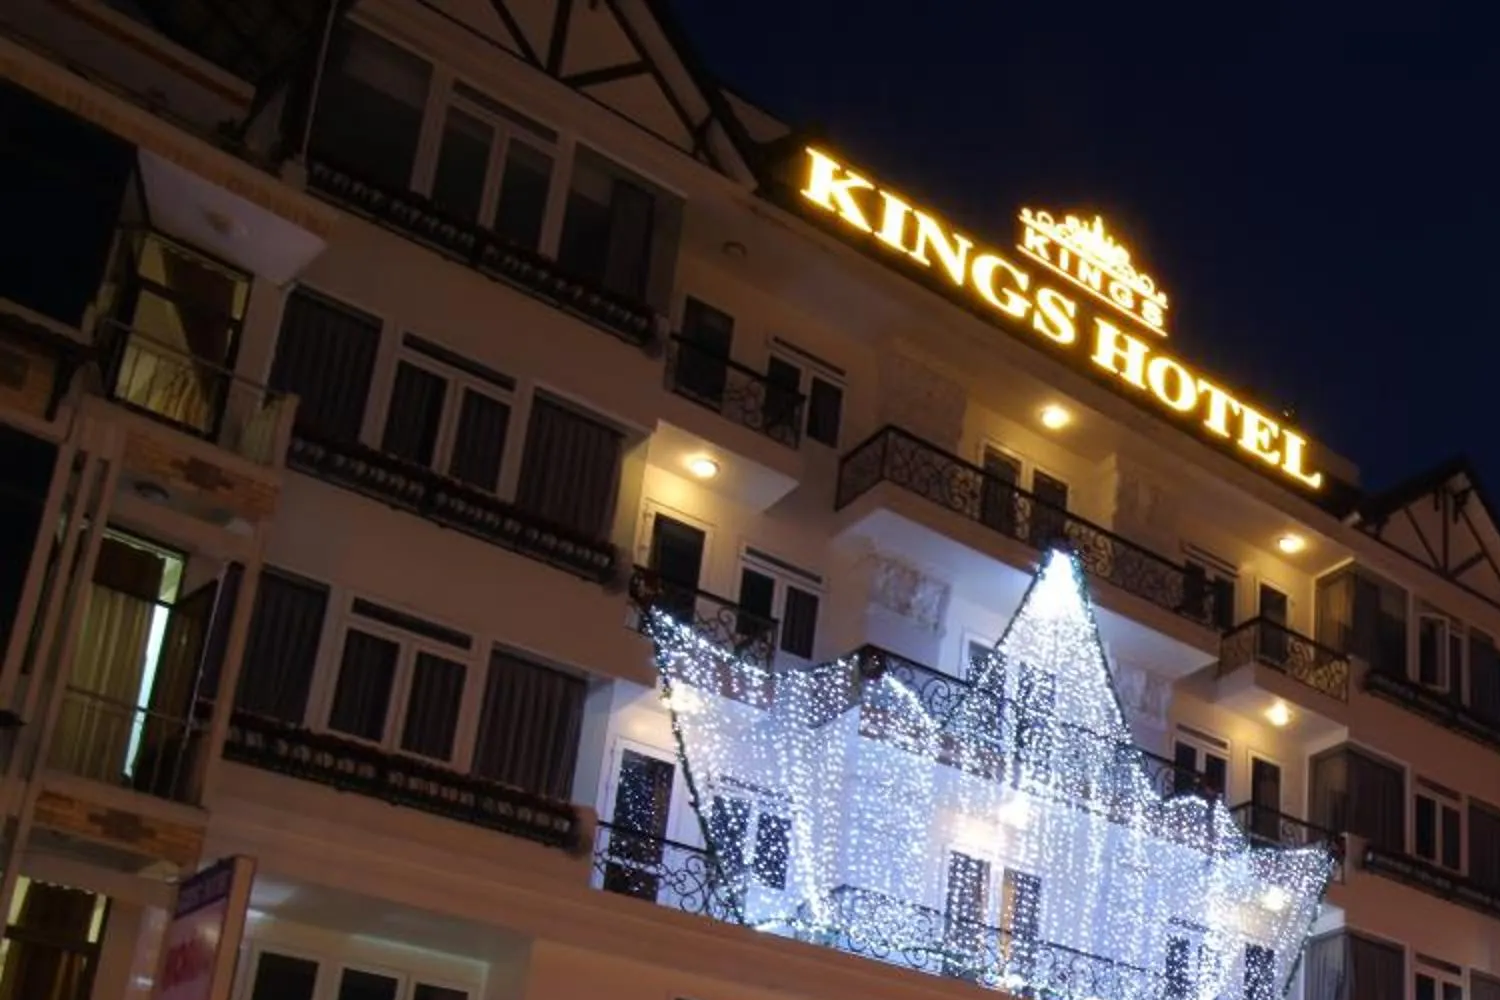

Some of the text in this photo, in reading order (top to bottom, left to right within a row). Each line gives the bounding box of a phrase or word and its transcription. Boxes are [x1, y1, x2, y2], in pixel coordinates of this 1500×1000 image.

[800, 146, 1322, 489] KINGS HOTEL
[1022, 225, 1165, 328] KINGS
